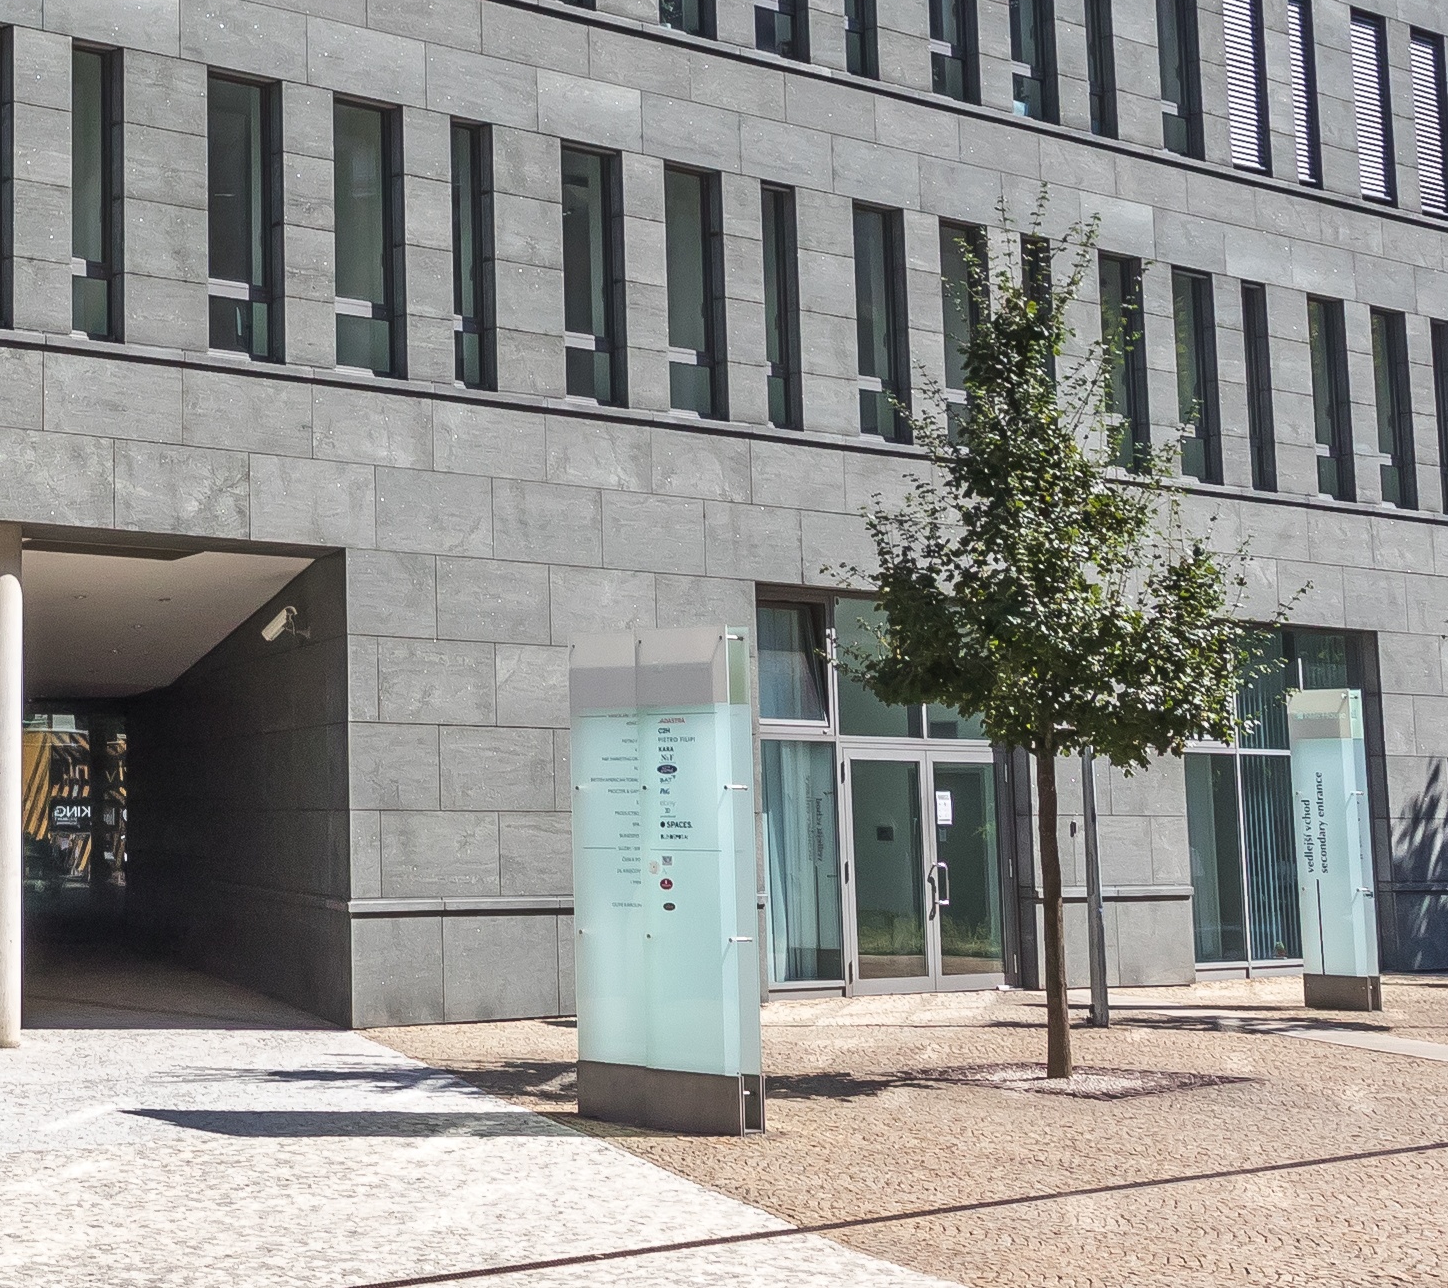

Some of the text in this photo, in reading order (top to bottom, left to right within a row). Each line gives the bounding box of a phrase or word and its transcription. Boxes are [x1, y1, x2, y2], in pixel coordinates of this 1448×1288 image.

[1301, 799, 1314, 873] vedlejší vchod
[1315, 771, 1329, 874] secondary entrance
